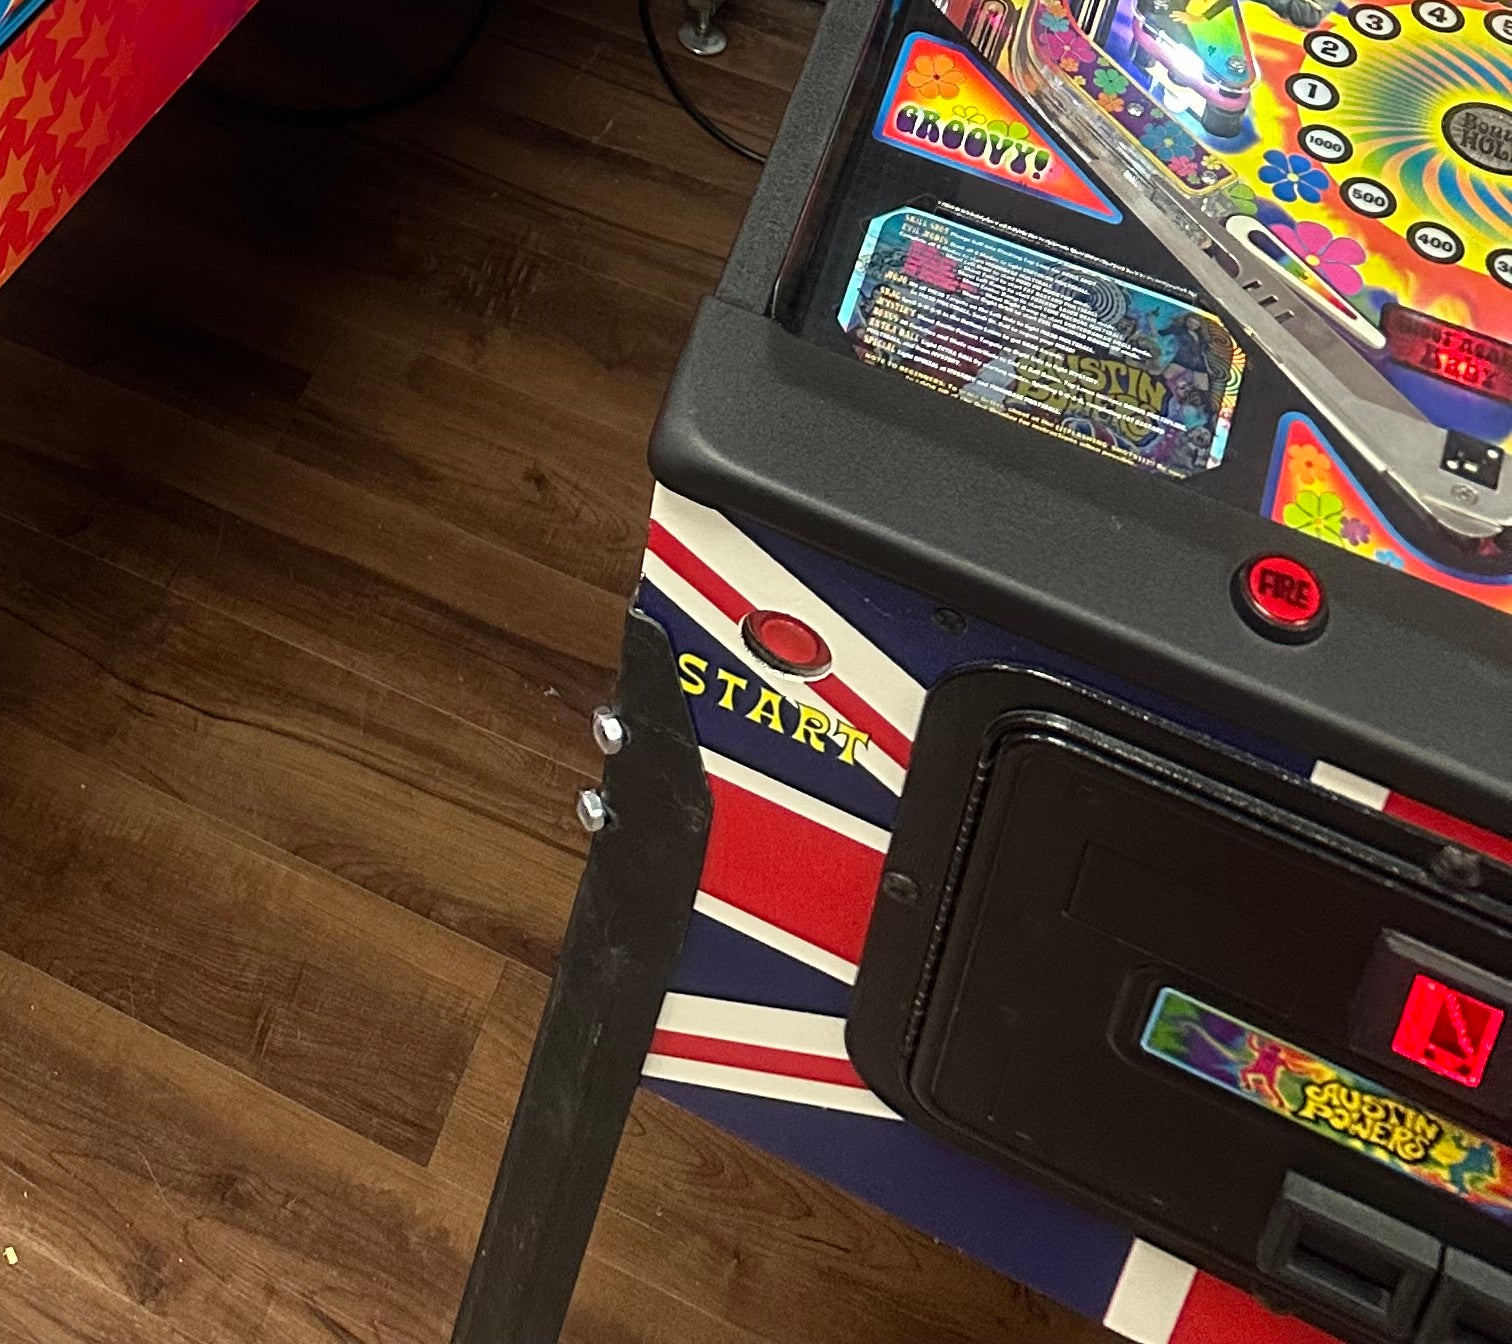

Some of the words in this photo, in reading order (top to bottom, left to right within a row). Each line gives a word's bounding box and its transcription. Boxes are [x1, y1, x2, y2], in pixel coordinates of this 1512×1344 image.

[1365, 14, 1384, 32] 3
[1427, 6, 1448, 24] 4
[1321, 40, 1339, 59] 2
[1307, 82, 1318, 100] 1
[895, 104, 1052, 181] GROOVY!
[1309, 134, 1343, 153] 1000
[1352, 186, 1386, 208] 500
[1418, 233, 1453, 253] 400
[869, 317, 899, 335] EXTRA
[900, 330, 921, 343] BALL
[863, 335, 896, 353] SPECIAL
[1257, 569, 1312, 608] FIRE
[676, 651, 873, 767] START
[1304, 1082, 1441, 1141] AUSTIN
[1297, 1097, 1431, 1162] POWERS
